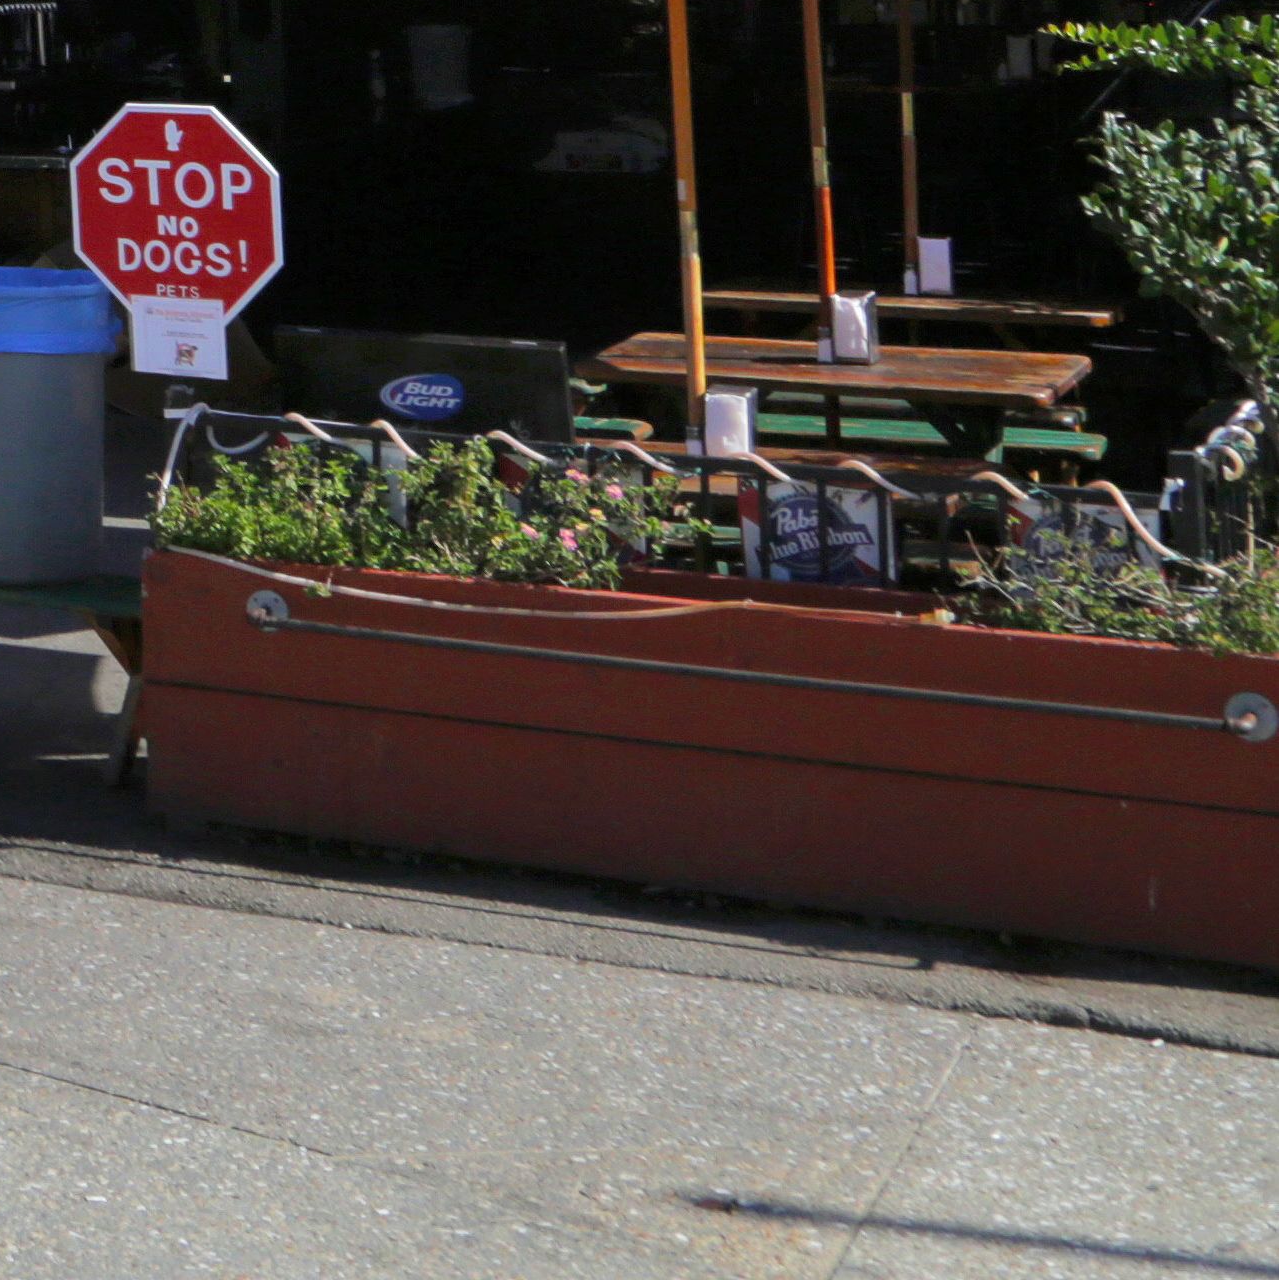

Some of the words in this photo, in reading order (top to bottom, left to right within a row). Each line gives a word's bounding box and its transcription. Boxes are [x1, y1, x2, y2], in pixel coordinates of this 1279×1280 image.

[98, 158, 252, 210] STOP
[157, 215, 198, 238] NO
[117, 238, 248, 277] DOGS!
[156, 284, 200, 299] PETS
[394, 392, 462, 409] LIGHT
[403, 382, 454, 396] BUD
[770, 506, 820, 537] Pabs
